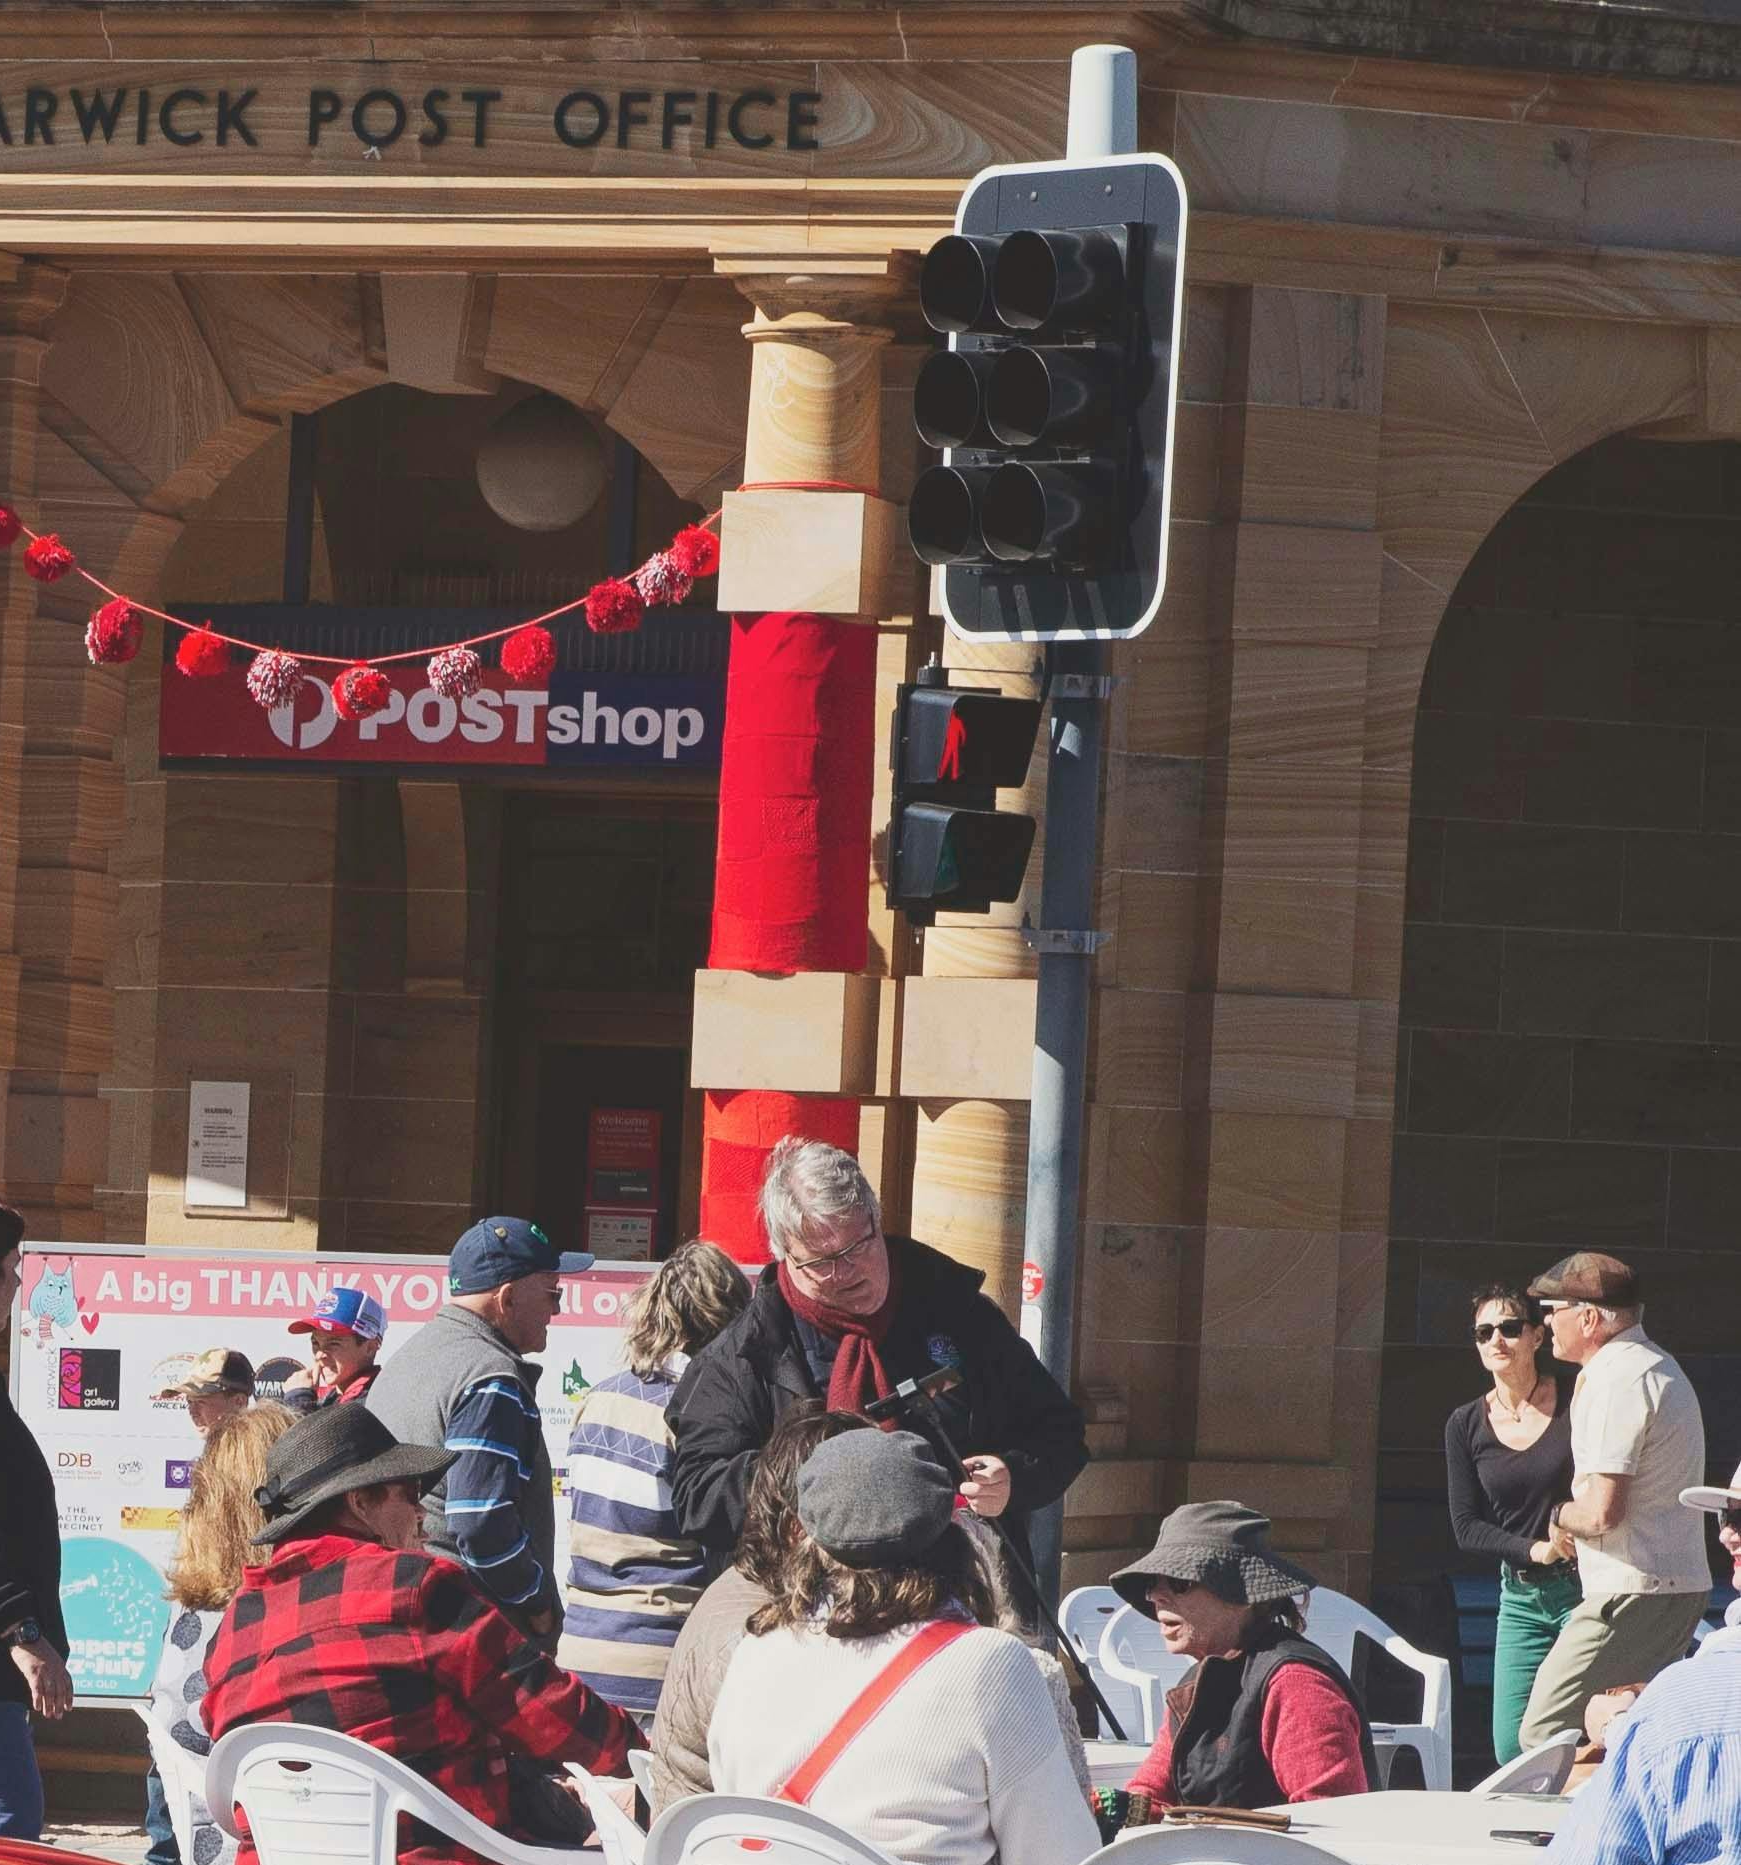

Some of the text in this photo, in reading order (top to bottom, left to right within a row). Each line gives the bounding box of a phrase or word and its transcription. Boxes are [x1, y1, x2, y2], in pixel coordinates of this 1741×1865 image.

[309, 88, 503, 149] POST
[553, 89, 824, 151] OFFICE
[96, 1270, 124, 1302] A
[133, 1270, 192, 1312] big
[46, 1346, 57, 1410] warwick
[83, 1387, 98, 1397] art
[83, 1397, 116, 1409] gallery
[67, 1506, 87, 1514] THE
[58, 1515, 102, 1523] ACTORY
